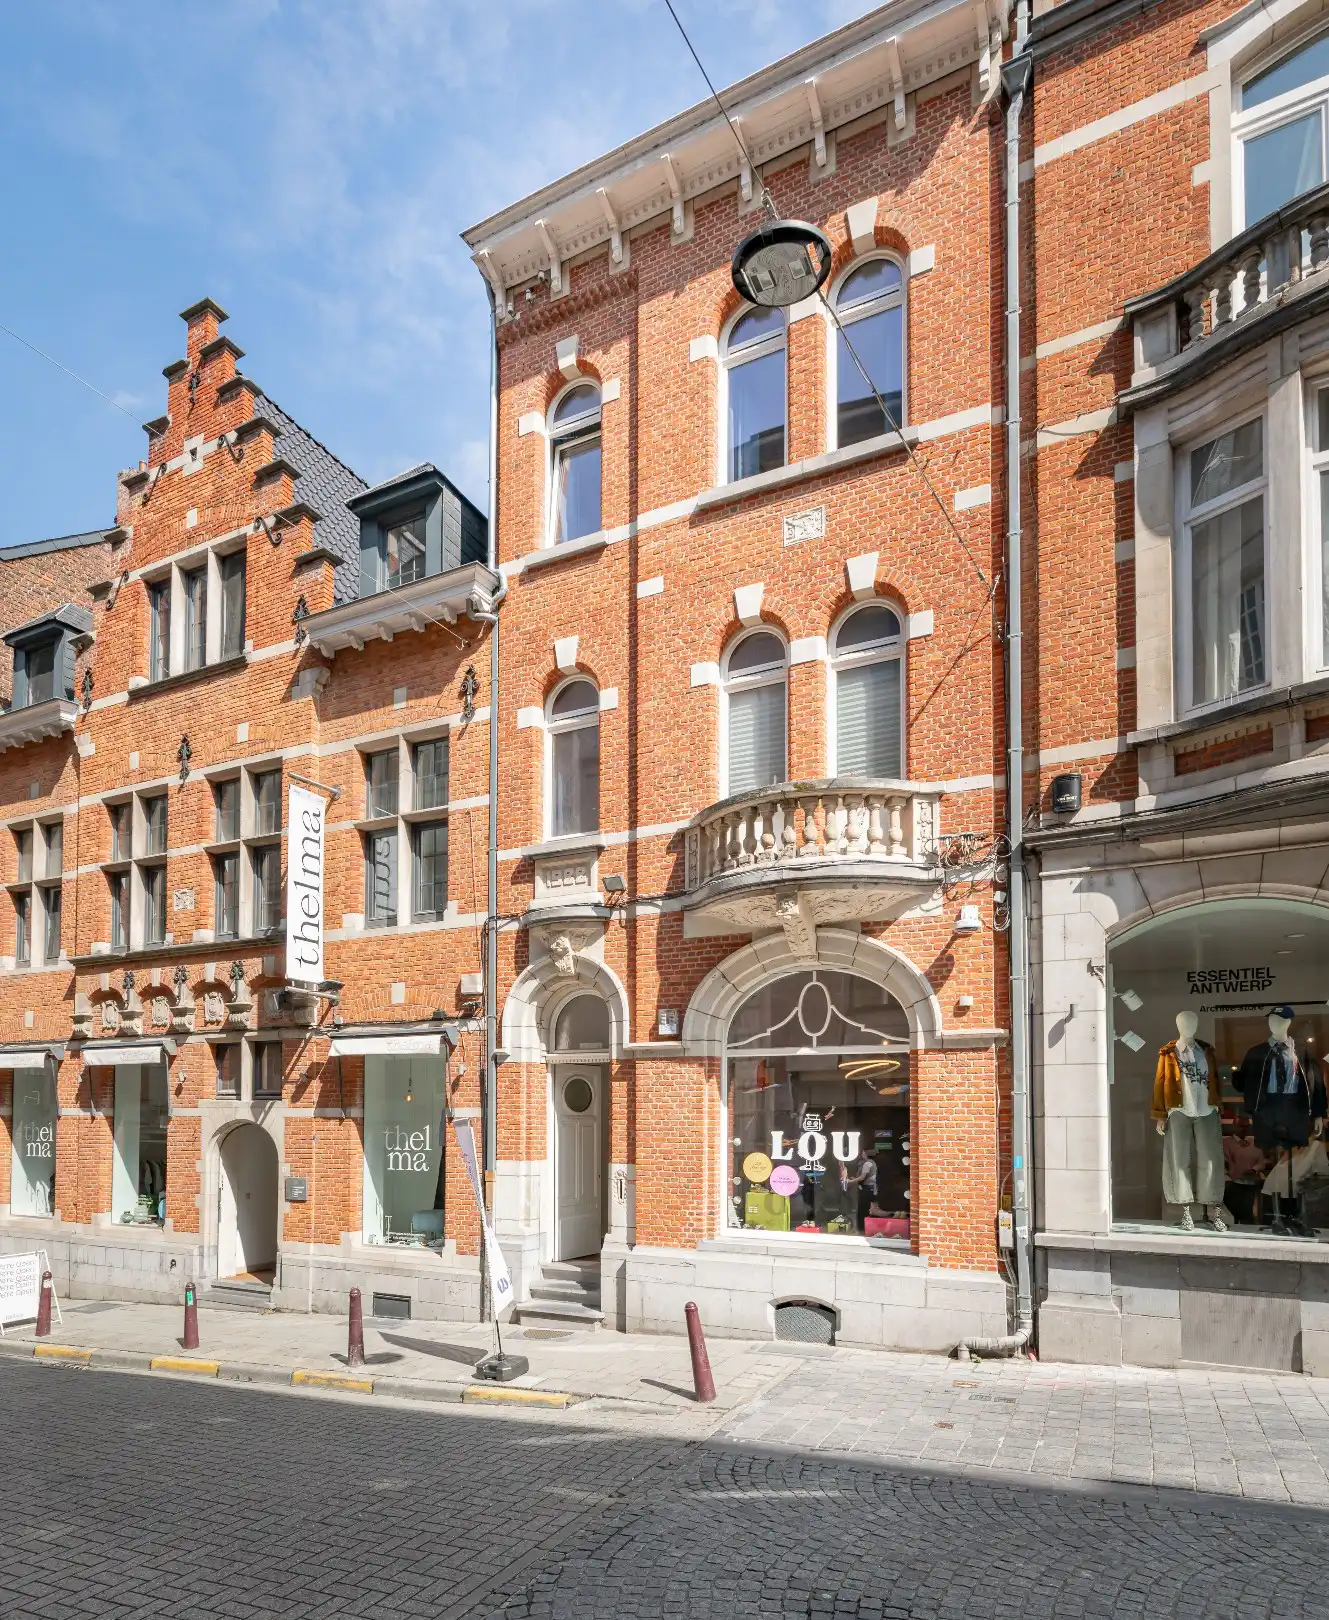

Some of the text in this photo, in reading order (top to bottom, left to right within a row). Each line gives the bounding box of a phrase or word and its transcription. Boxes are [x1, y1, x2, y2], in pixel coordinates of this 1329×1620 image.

[293, 807, 321, 968] thelma
[1187, 967, 1276, 983] ESSENTIEL
[1190, 979, 1273, 994] ANTWERP
[24, 1122, 54, 1142] thel
[383, 1125, 432, 1151] thel
[26, 1142, 52, 1158] ma
[771, 1131, 860, 1161] LOU
[387, 1151, 430, 1172] ma
